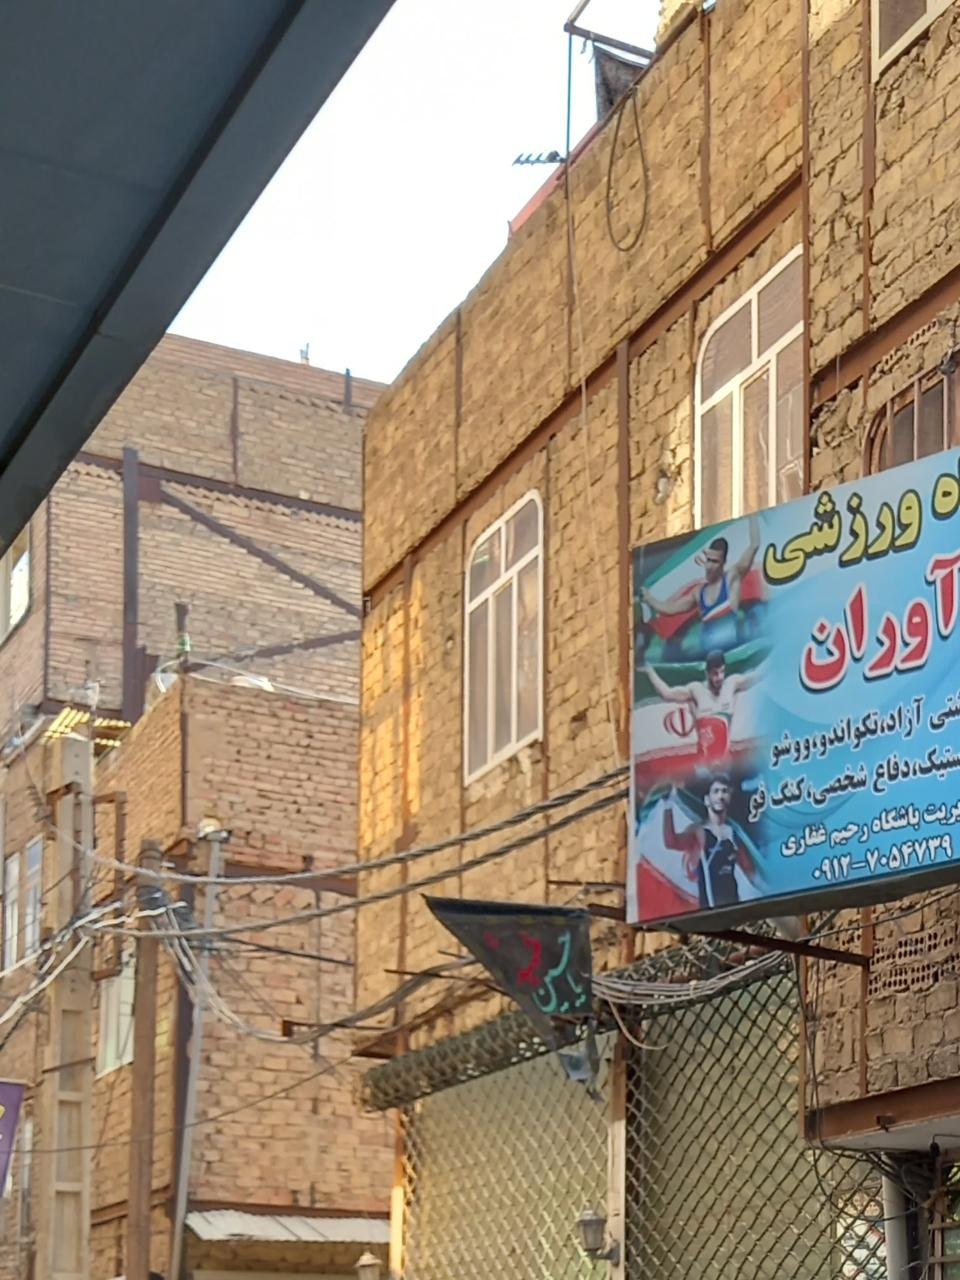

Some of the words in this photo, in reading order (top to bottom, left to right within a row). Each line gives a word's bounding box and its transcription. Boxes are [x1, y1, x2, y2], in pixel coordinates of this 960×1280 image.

[763, 489, 921, 584] ورزشی
[872, 803, 920, 833] باشگاه
[781, 824, 827, 857] غفاری
[830, 821, 868, 847] رحیم
